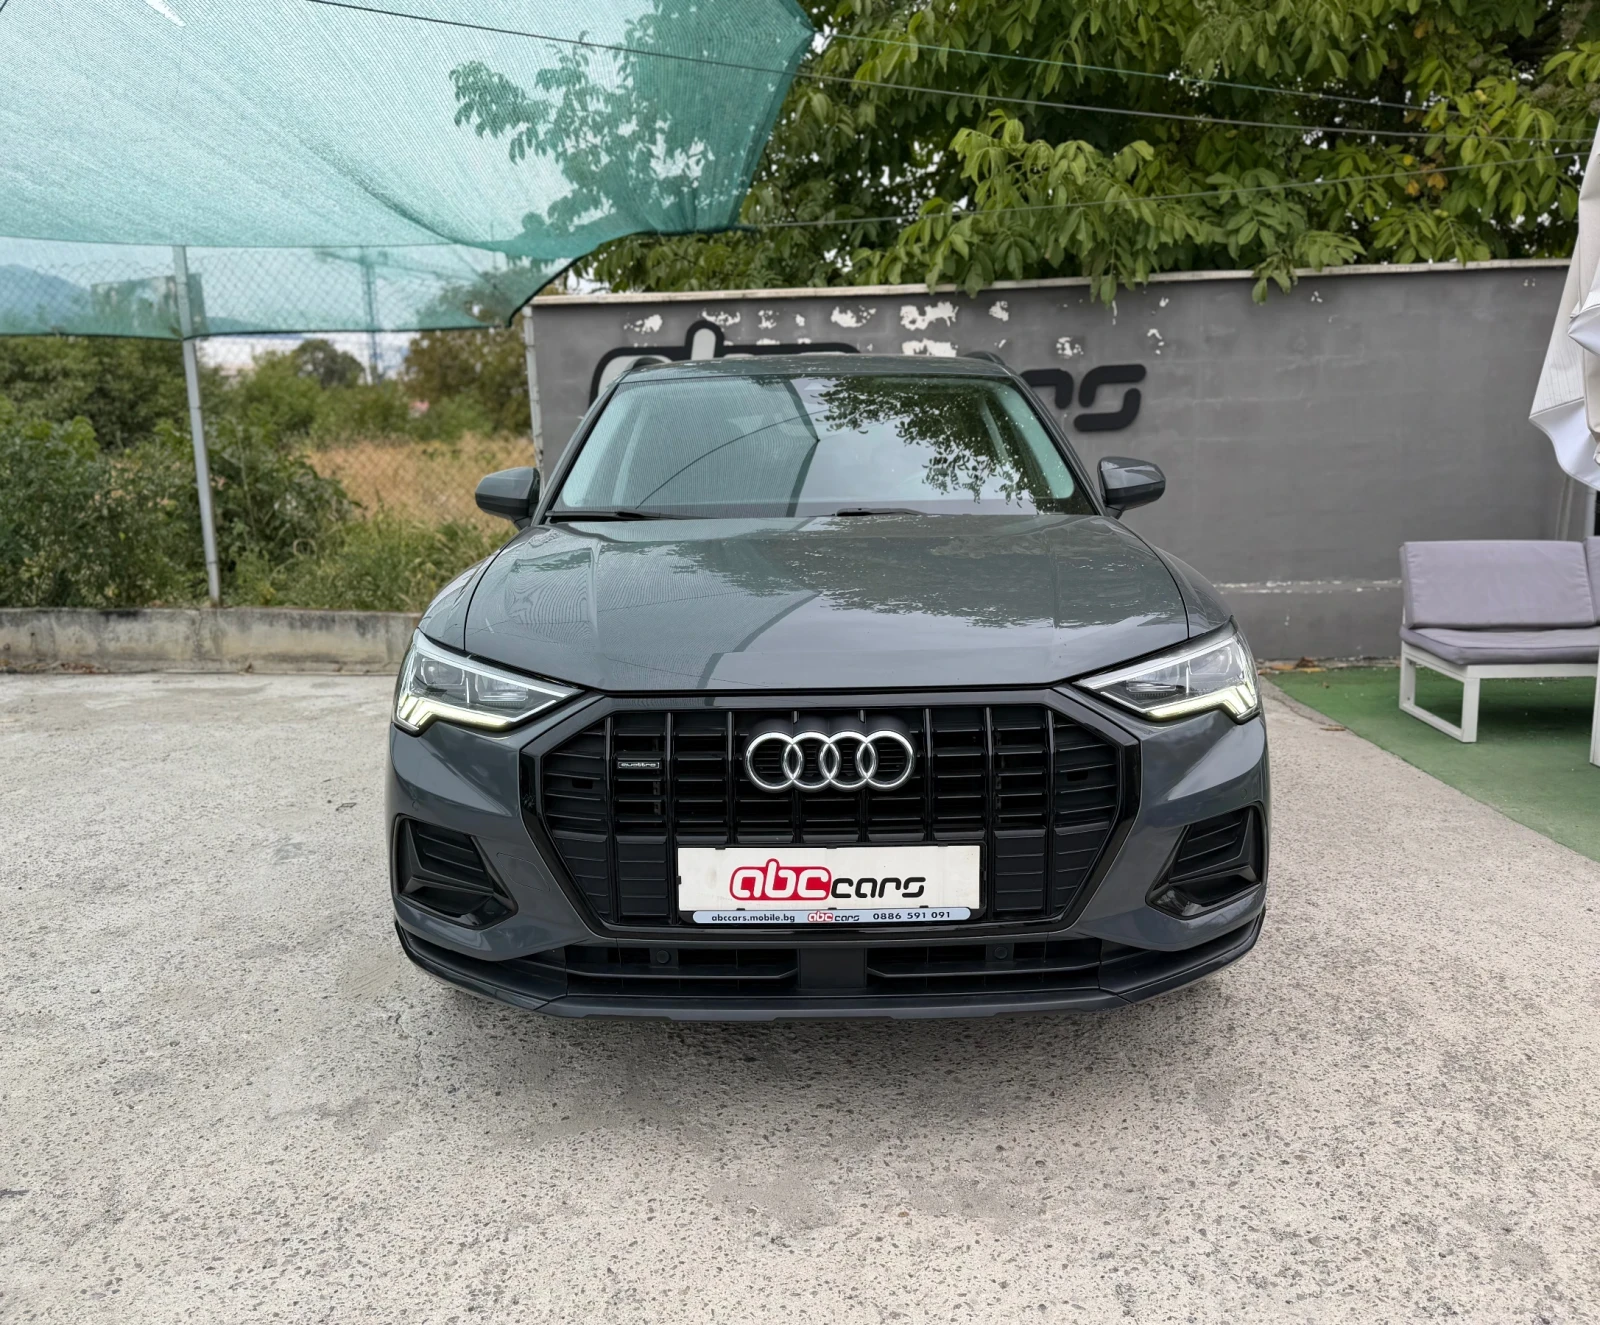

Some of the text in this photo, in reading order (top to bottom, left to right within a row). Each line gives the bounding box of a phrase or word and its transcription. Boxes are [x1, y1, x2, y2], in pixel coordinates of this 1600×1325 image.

[731, 859, 926, 899] abc cars
[711, 913, 796, 923] abccars.mobile.bg
[873, 912, 902, 920] 0886
[907, 911, 926, 919] 591
[931, 911, 951, 919] 091
